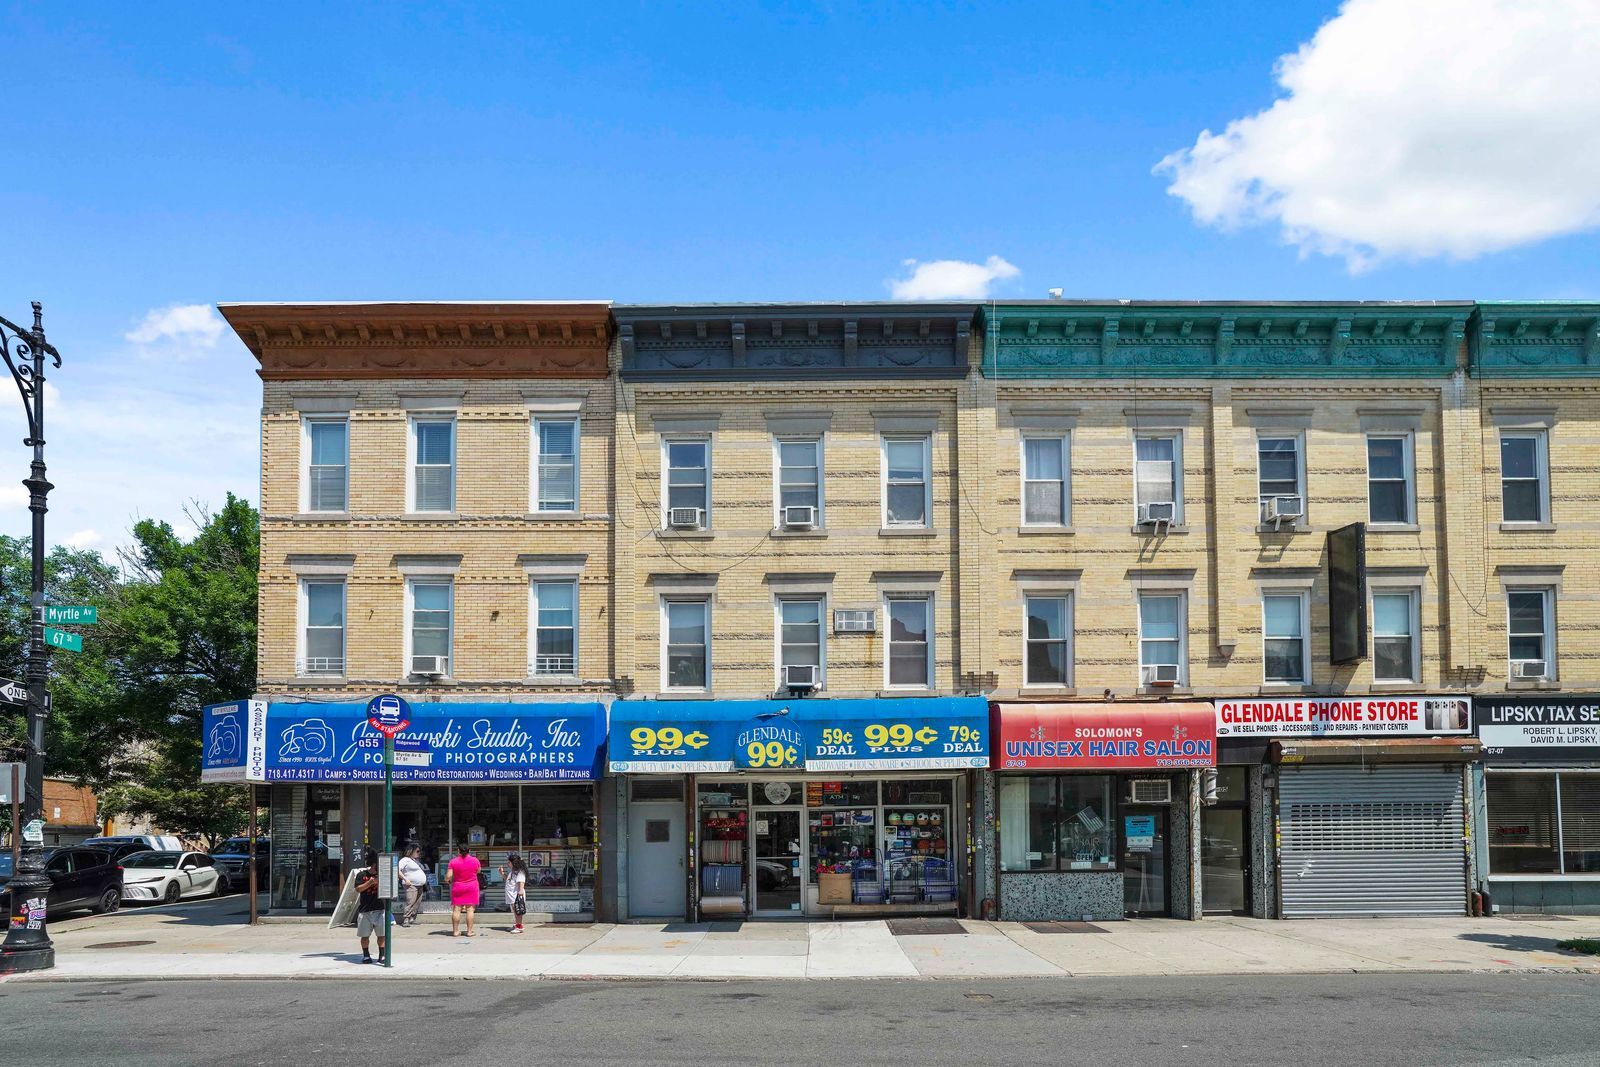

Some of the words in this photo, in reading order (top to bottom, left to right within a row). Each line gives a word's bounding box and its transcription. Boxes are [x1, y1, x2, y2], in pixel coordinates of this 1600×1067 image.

[49, 608, 79, 621] Myrtle
[54, 632, 64, 645] 67
[7, 687, 26, 698] ONE
[1221, 702, 1303, 723] GLENDALE
[1308, 702, 1362, 722] PHONE
[1368, 702, 1418, 720] STORE
[1492, 706, 1544, 722] LIPSKY
[1547, 706, 1575, 721] TAX
[254, 702, 262, 741] PASSPORT
[381, 722, 407, 732] STANDING
[467, 719, 532, 752] Studio,
[542, 718, 581, 748] Inc.
[630, 727, 709, 750] 99¢
[738, 726, 801, 746] GLENDALE
[822, 728, 853, 744] 59¢
[864, 724, 938, 746] 99¢
[949, 726, 980, 742] 79¢
[1075, 728, 1142, 738] SOLOMON'S
[358, 739, 379, 748] Q55
[1567, 736, 1597, 744] LIPSKY,
[747, 742, 798, 767] 99¢
[816, 746, 856, 755] DEAL
[943, 743, 983, 753] DEAL
[1006, 741, 1084, 757] UNISEX
[1089, 740, 1139, 756] HAIR
[1144, 740, 1211, 756] SALON
[252, 747, 262, 776] PHOTOS
[446, 752, 574, 763] PHOTOGRAPHERS
[809, 760, 848, 770] HARDWARE
[854, 760, 878, 769] HOUSE
[879, 760, 899, 769] WARE
[905, 759, 932, 768] SCHOOL
[936, 758, 967, 768] SUPPLIES
[631, 762, 657, 771] BEAUTY
[660, 762, 670, 771] AID
[676, 762, 707, 771] SUPPLIES
[268, 770, 314, 778] 718.417.4317
